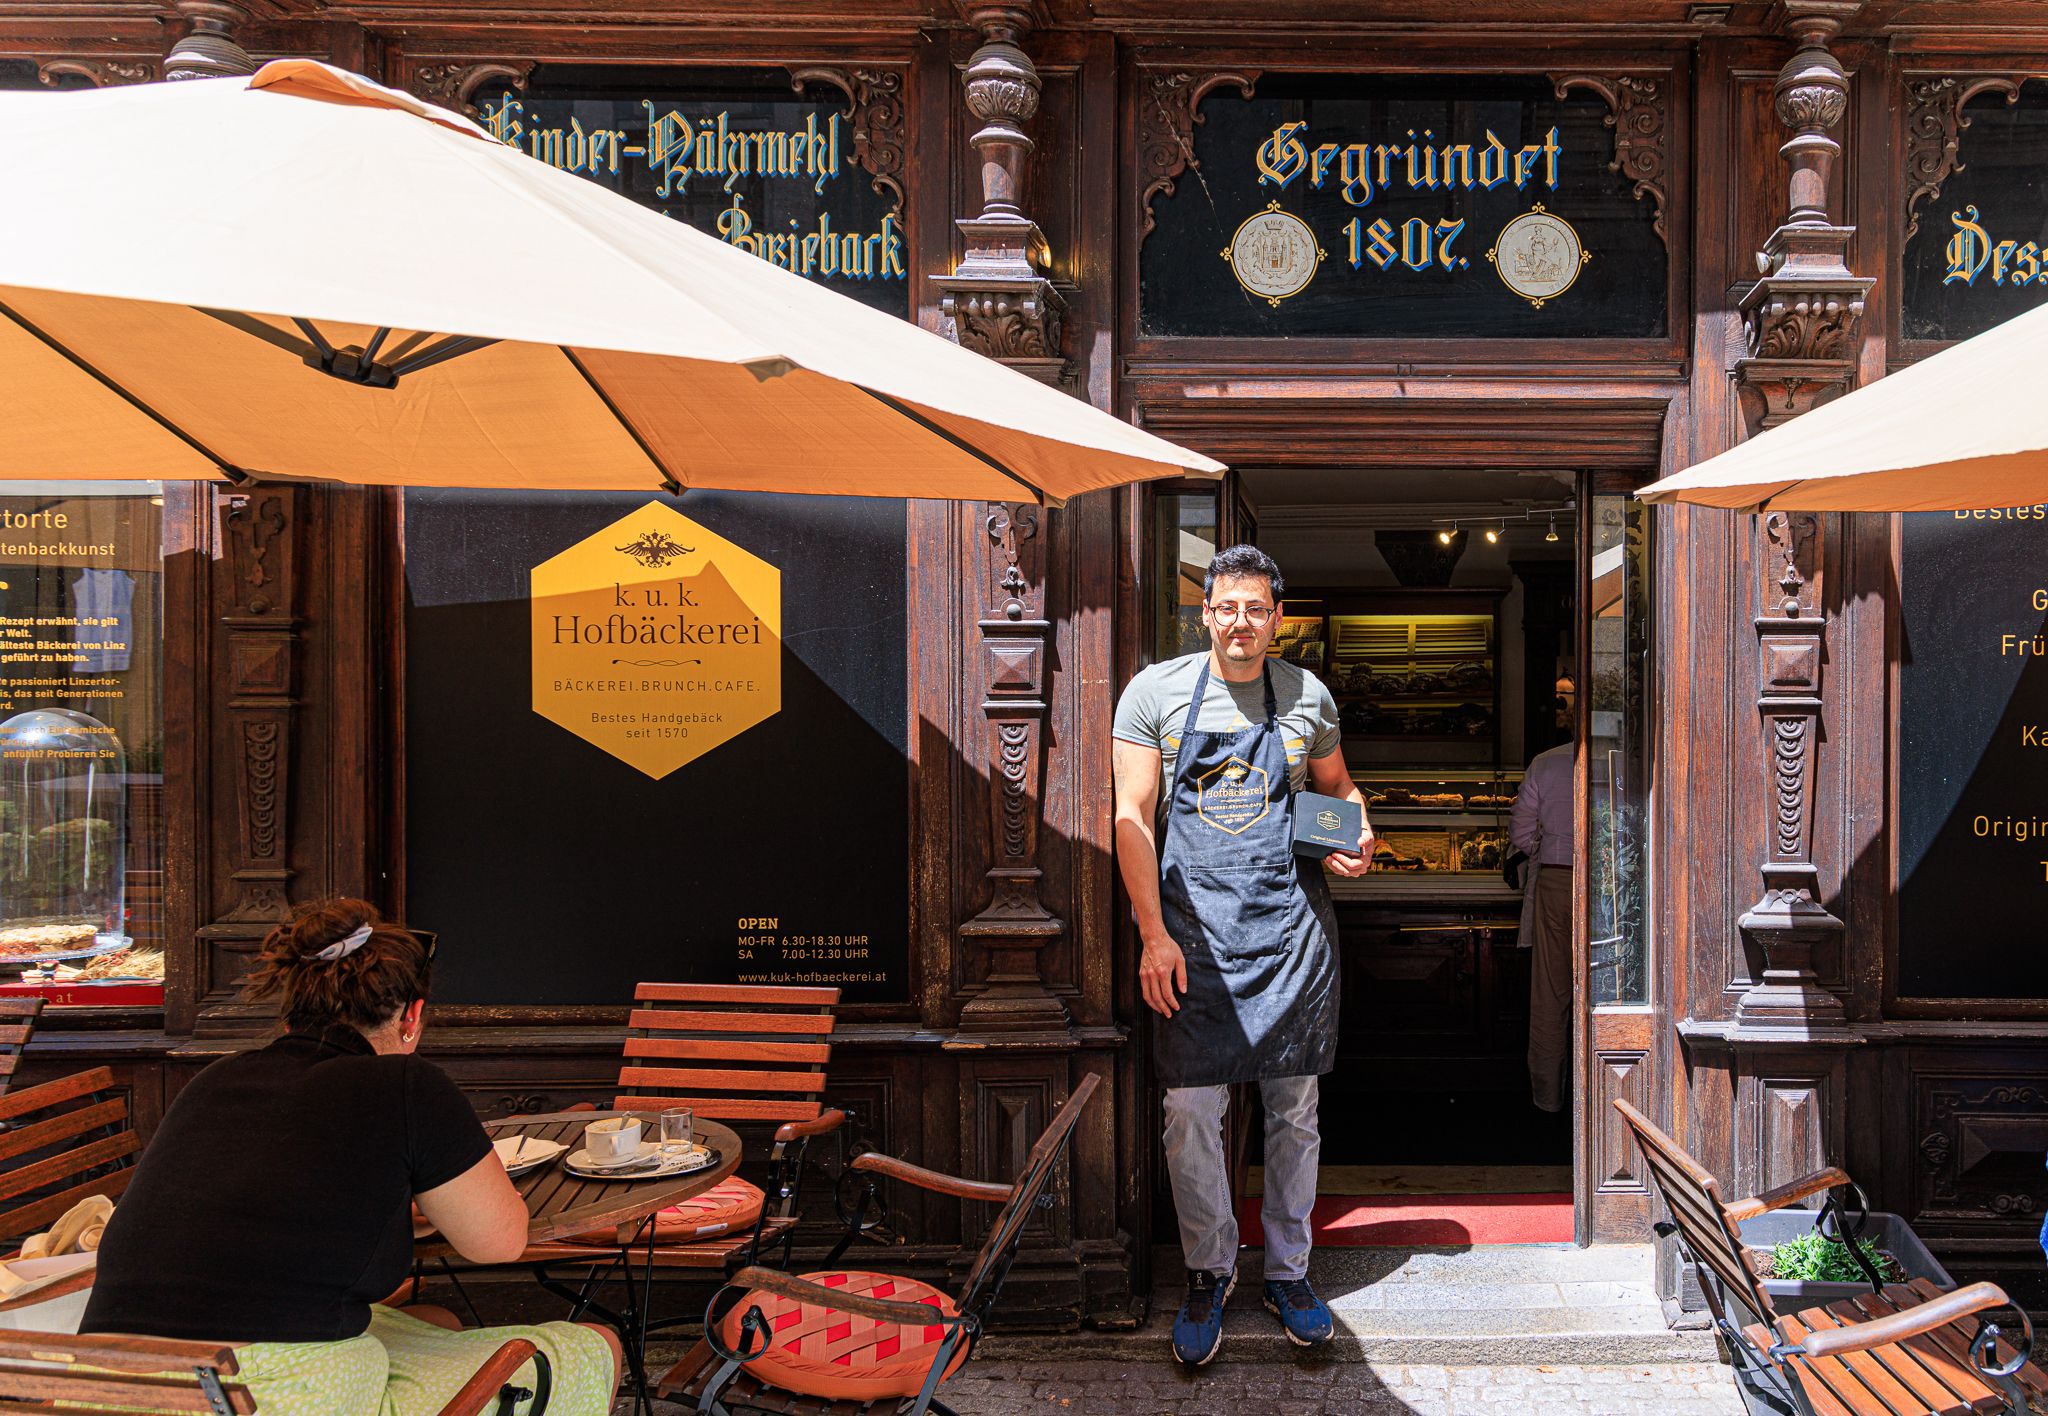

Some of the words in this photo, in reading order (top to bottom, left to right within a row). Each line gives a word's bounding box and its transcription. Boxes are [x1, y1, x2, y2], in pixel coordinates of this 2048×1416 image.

[1255, 120, 1563, 207] Gegründet
[1342, 216, 1469, 272] 1807.
[1, 542, 115, 556] tenbackkunst
[614, 582, 636, 607] k.
[646, 590, 668, 607] u.
[678, 582, 699, 607] k.
[36, 616, 81, 626] erwähnt,
[83, 616, 99, 626] sie
[101, 616, 119, 628] gilt
[6, 628, 32, 638] Welt.
[551, 614, 761, 645] Hofbäckerei
[36, 640, 81, 650] Bäckerei
[104, 640, 126, 650] Linz
[1, 652, 39, 663] geführt
[41, 654, 53, 662] zu
[55, 652, 90, 662] haben.
[10, 677, 67, 687] passioniert
[69, 677, 121, 686] Linzertor-
[554, 678, 761, 692] BÄCKEREI.BRUNCH.CAFE.
[14, 689, 33, 698] das
[35, 689, 54, 698] seit
[56, 689, 124, 698] Generationen
[591, 712, 637, 723] Bestes
[642, 712, 723, 725] Handgebäck
[626, 728, 652, 738] seit
[657, 728, 688, 738] 1570
[3, 749, 44, 758] anfühlt?
[47, 749, 97, 758] Probieren
[99, 749, 116, 758] Sie
[738, 917, 778, 930] OPEN
[738, 936, 775, 946] MO-FR
[782, 936, 841, 946] 6.30-18.30
[845, 935, 868, 945] UHR
[738, 949, 753, 959] SA
[782, 949, 841, 959] 7.00-12.30
[845, 949, 869, 958] UHR
[738, 971, 887, 982] www.kuk-hofbaeckerei.at
